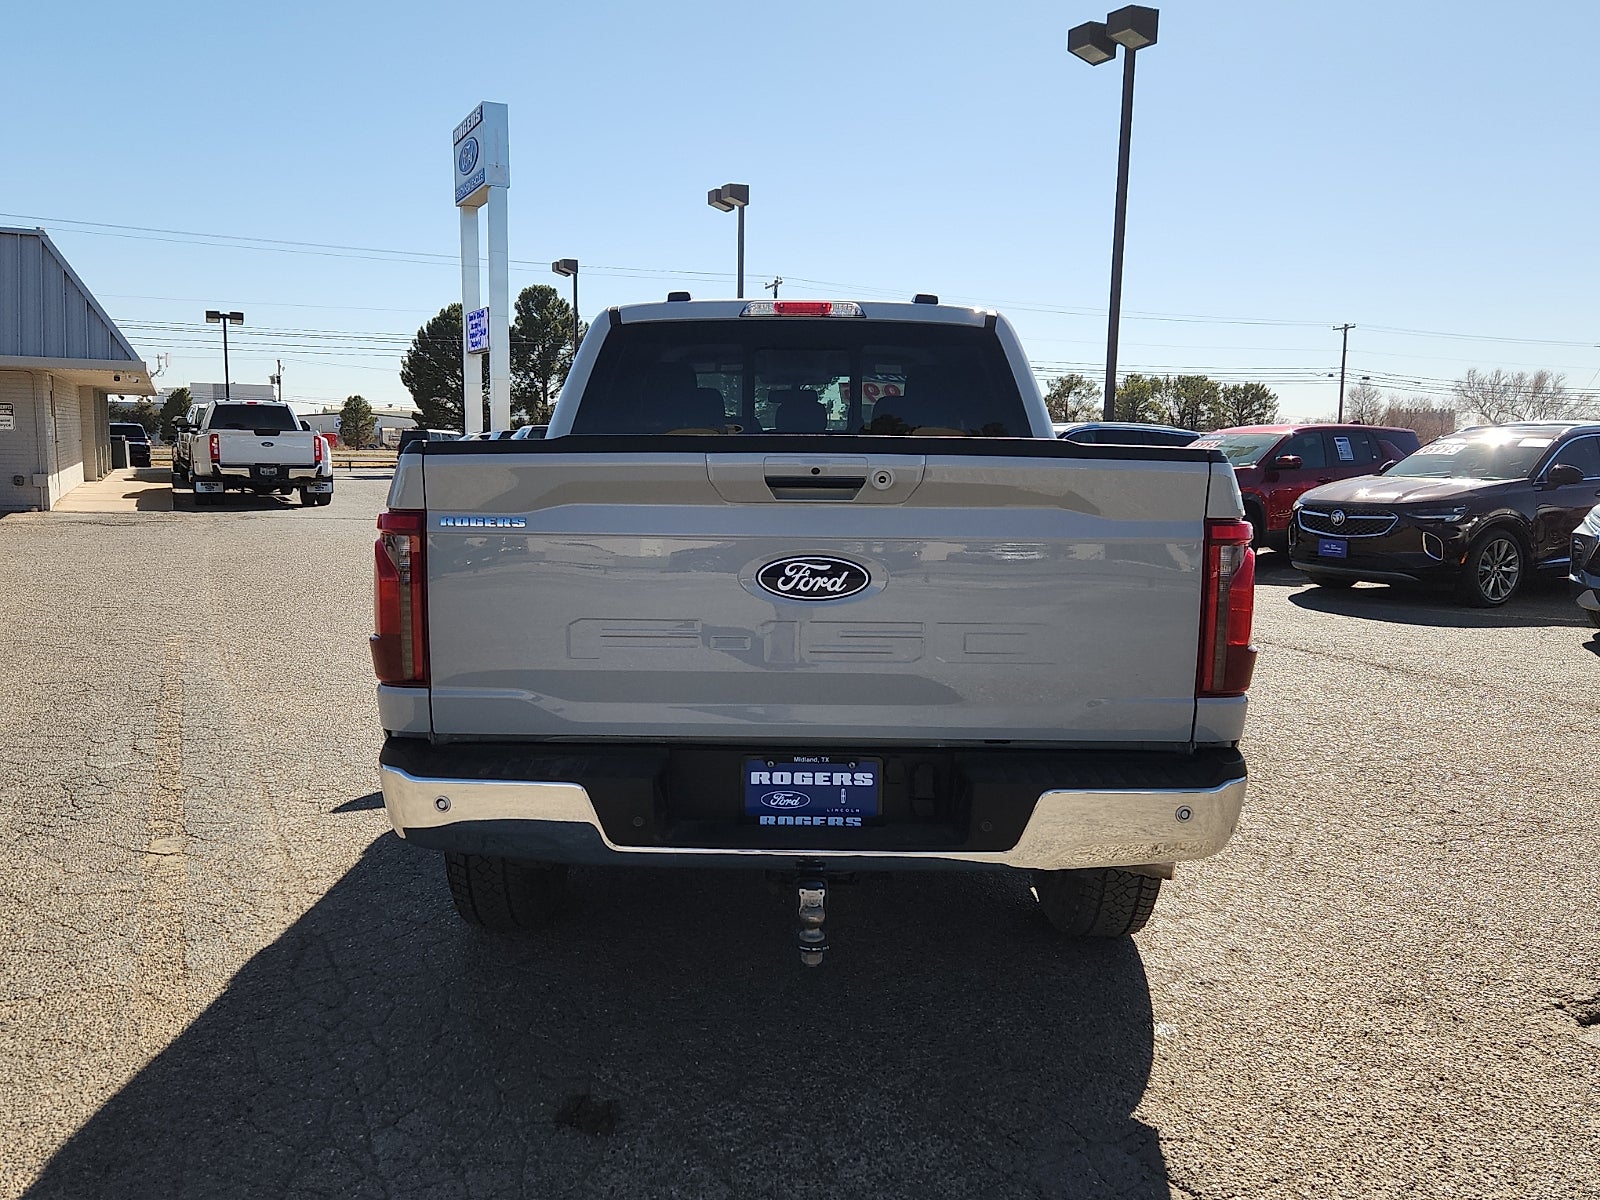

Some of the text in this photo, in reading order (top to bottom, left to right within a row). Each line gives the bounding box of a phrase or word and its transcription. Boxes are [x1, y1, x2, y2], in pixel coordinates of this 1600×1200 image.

[453, 107, 482, 143] ROGERS
[440, 516, 526, 528] ROGERS
[778, 562, 849, 593] Ford
[566, 617, 1058, 665] F-150
[750, 771, 874, 786] ROGERS
[770, 792, 801, 806] Ford
[759, 815, 862, 827] ROGERS
